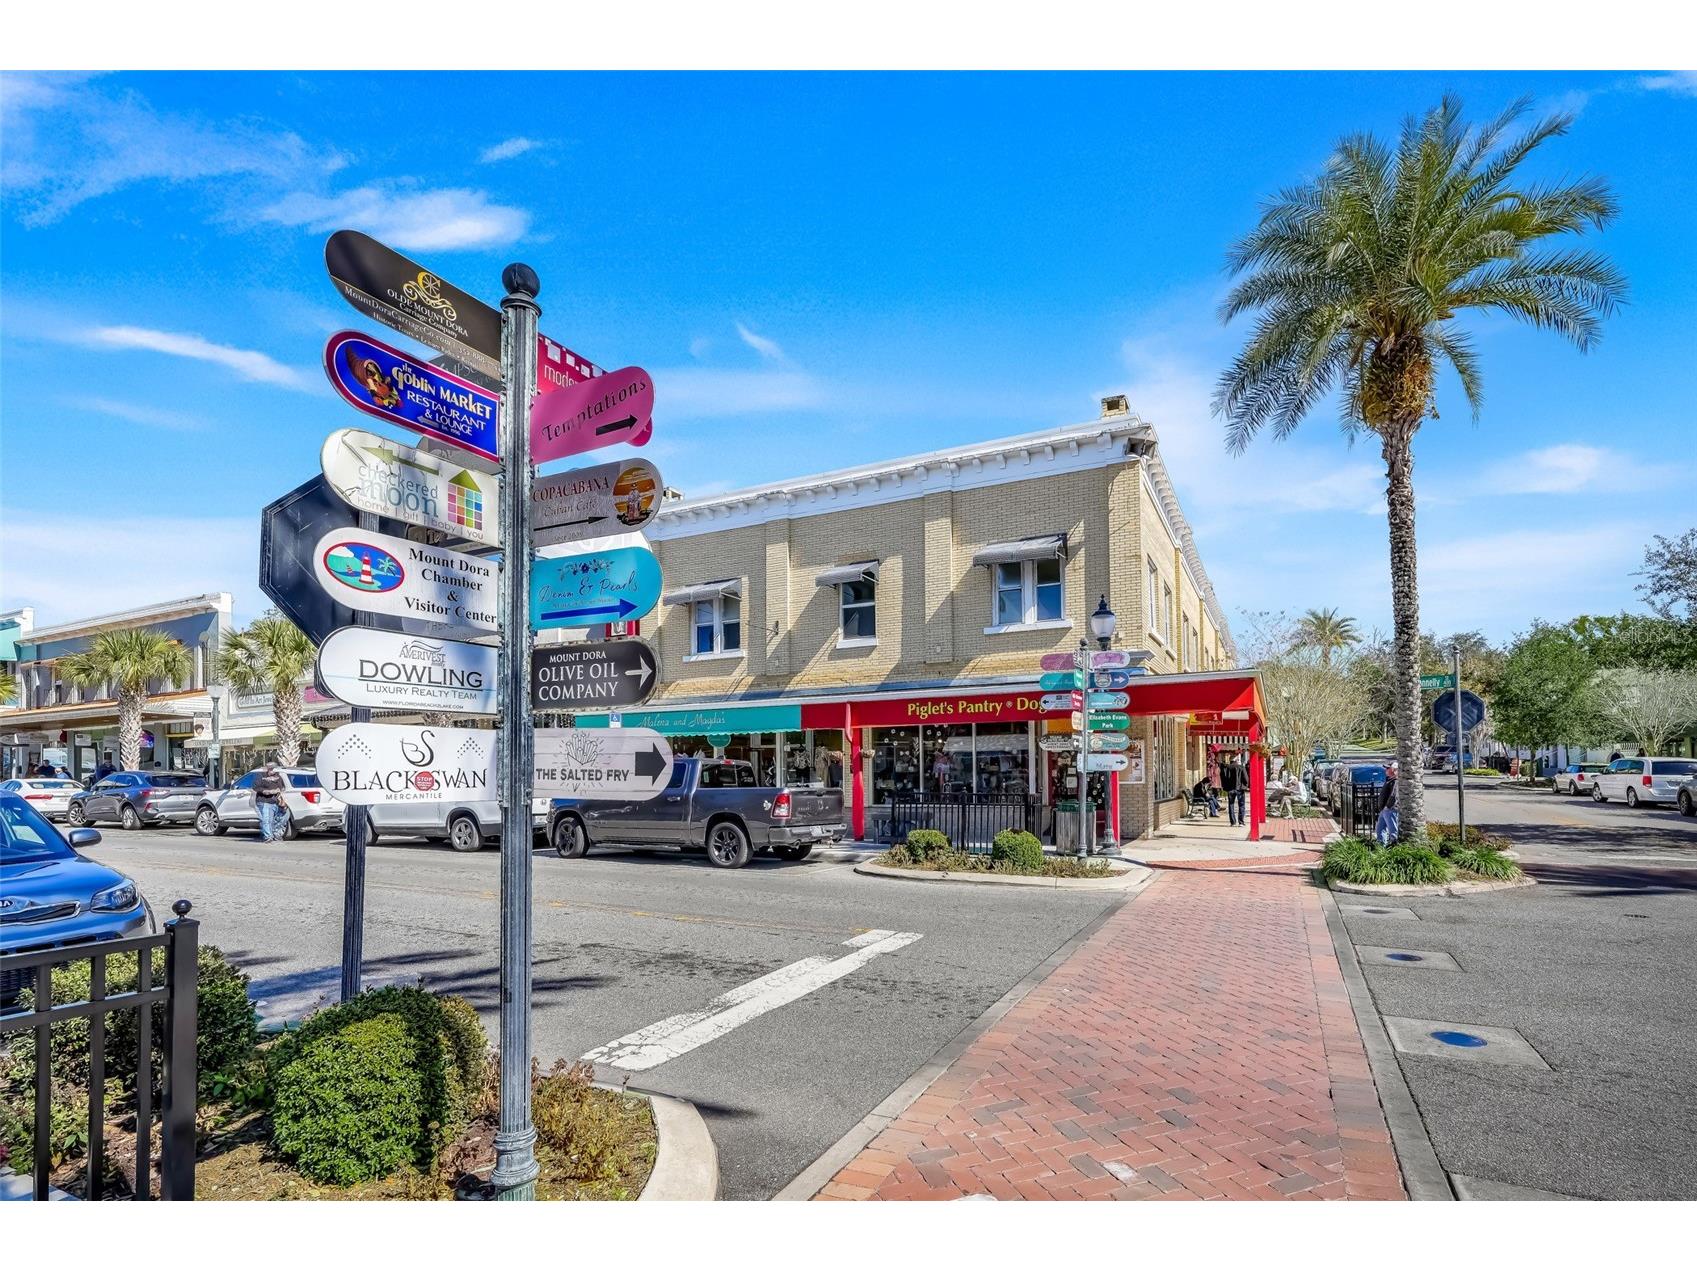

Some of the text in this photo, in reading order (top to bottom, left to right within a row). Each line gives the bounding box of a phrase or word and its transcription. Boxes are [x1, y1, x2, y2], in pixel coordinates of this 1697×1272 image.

[387, 288, 469, 337] OLDE MOUNT DORA
[399, 303, 458, 339] Carriage Company
[407, 390, 486, 431] RESTAURANT
[424, 409, 472, 436] & LOUNGE
[542, 379, 646, 441] Temptations
[359, 465, 438, 499] checkered
[532, 477, 609, 502] COPACABANA
[359, 479, 438, 518] moon
[357, 497, 484, 540] home gift baby you
[409, 548, 490, 577] Mount Dora
[422, 568, 483, 591] Chamber
[538, 585, 574, 602] Denim
[599, 570, 638, 596] Pearls
[447, 590, 458, 602] &
[404, 596, 497, 624] Visitor Center
[549, 651, 606, 663] MOUNT DORA
[359, 659, 483, 688] DOWLING
[538, 662, 619, 683] OLIVE OIL
[367, 683, 477, 700] LUXURY REALTY TEAM
[538, 681, 618, 701] COMPANY
[673, 714, 688, 726] and
[907, 701, 954, 719] Piglet's
[958, 698, 1003, 717] Pantry
[332, 768, 488, 793] BLACK SWAN
[536, 768, 630, 782] THE SALTED FRY
